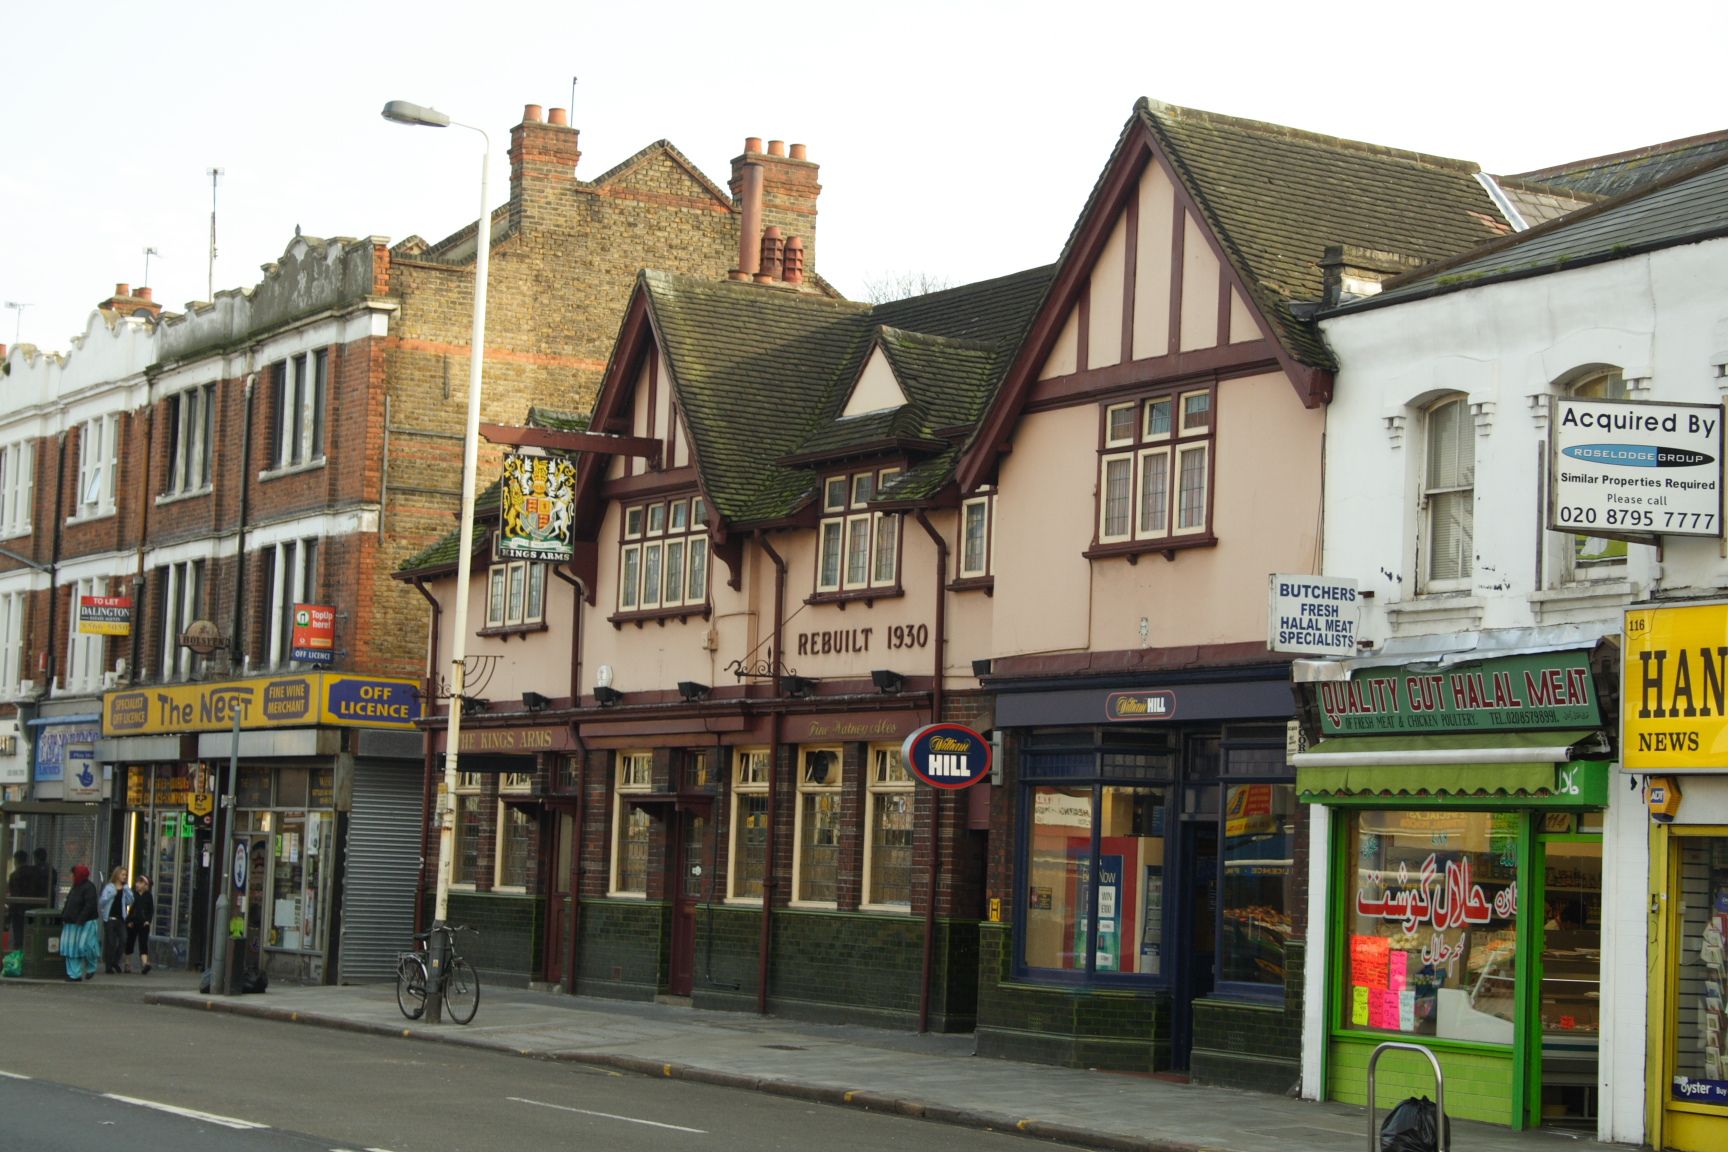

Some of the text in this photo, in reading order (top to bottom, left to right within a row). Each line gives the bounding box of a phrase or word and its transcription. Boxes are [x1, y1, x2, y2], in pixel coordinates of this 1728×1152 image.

[1562, 407, 1715, 438] Acquired By
[1574, 448, 1704, 463] ROSELODGE GROUP
[1561, 472, 1715, 491] Similar Properties Required
[1607, 493, 1667, 506] Please call
[1560, 506, 1714, 530] 020 8795 7777
[502, 548, 570, 561] KINGS ARMS
[1280, 583, 1356, 602] BUTCHERS
[105, 598, 119, 606] LET
[1301, 603, 1339, 618] FRESH
[81, 606, 129, 617] DALINGTON
[312, 611, 333, 621] TopUp
[1281, 616, 1354, 633] HALAL MEAT
[1629, 619, 1645, 631] 116
[797, 623, 929, 656] REBUILT 1930
[1279, 631, 1354, 648] SPECIALISTS
[269, 684, 305, 699] FINE WINE
[360, 686, 393, 700] OFF
[1321, 668, 1589, 729] QUALITY CUT HALAL MEAT
[157, 693, 194, 726] The
[267, 700, 305, 714] MERCHANT
[340, 701, 409, 718] LICENCE
[1115, 696, 1166, 715] William HILL
[1354, 717, 1375, 730] FRESH
[1376, 716, 1396, 729] MEAT
[1407, 714, 1439, 728] CHICKEN
[459, 730, 553, 749] HE KINGS ARMS
[929, 735, 971, 753] William
[1638, 732, 1700, 752] NEWS
[928, 754, 971, 776] HILL
[1680, 1081, 1712, 1096] oyster
